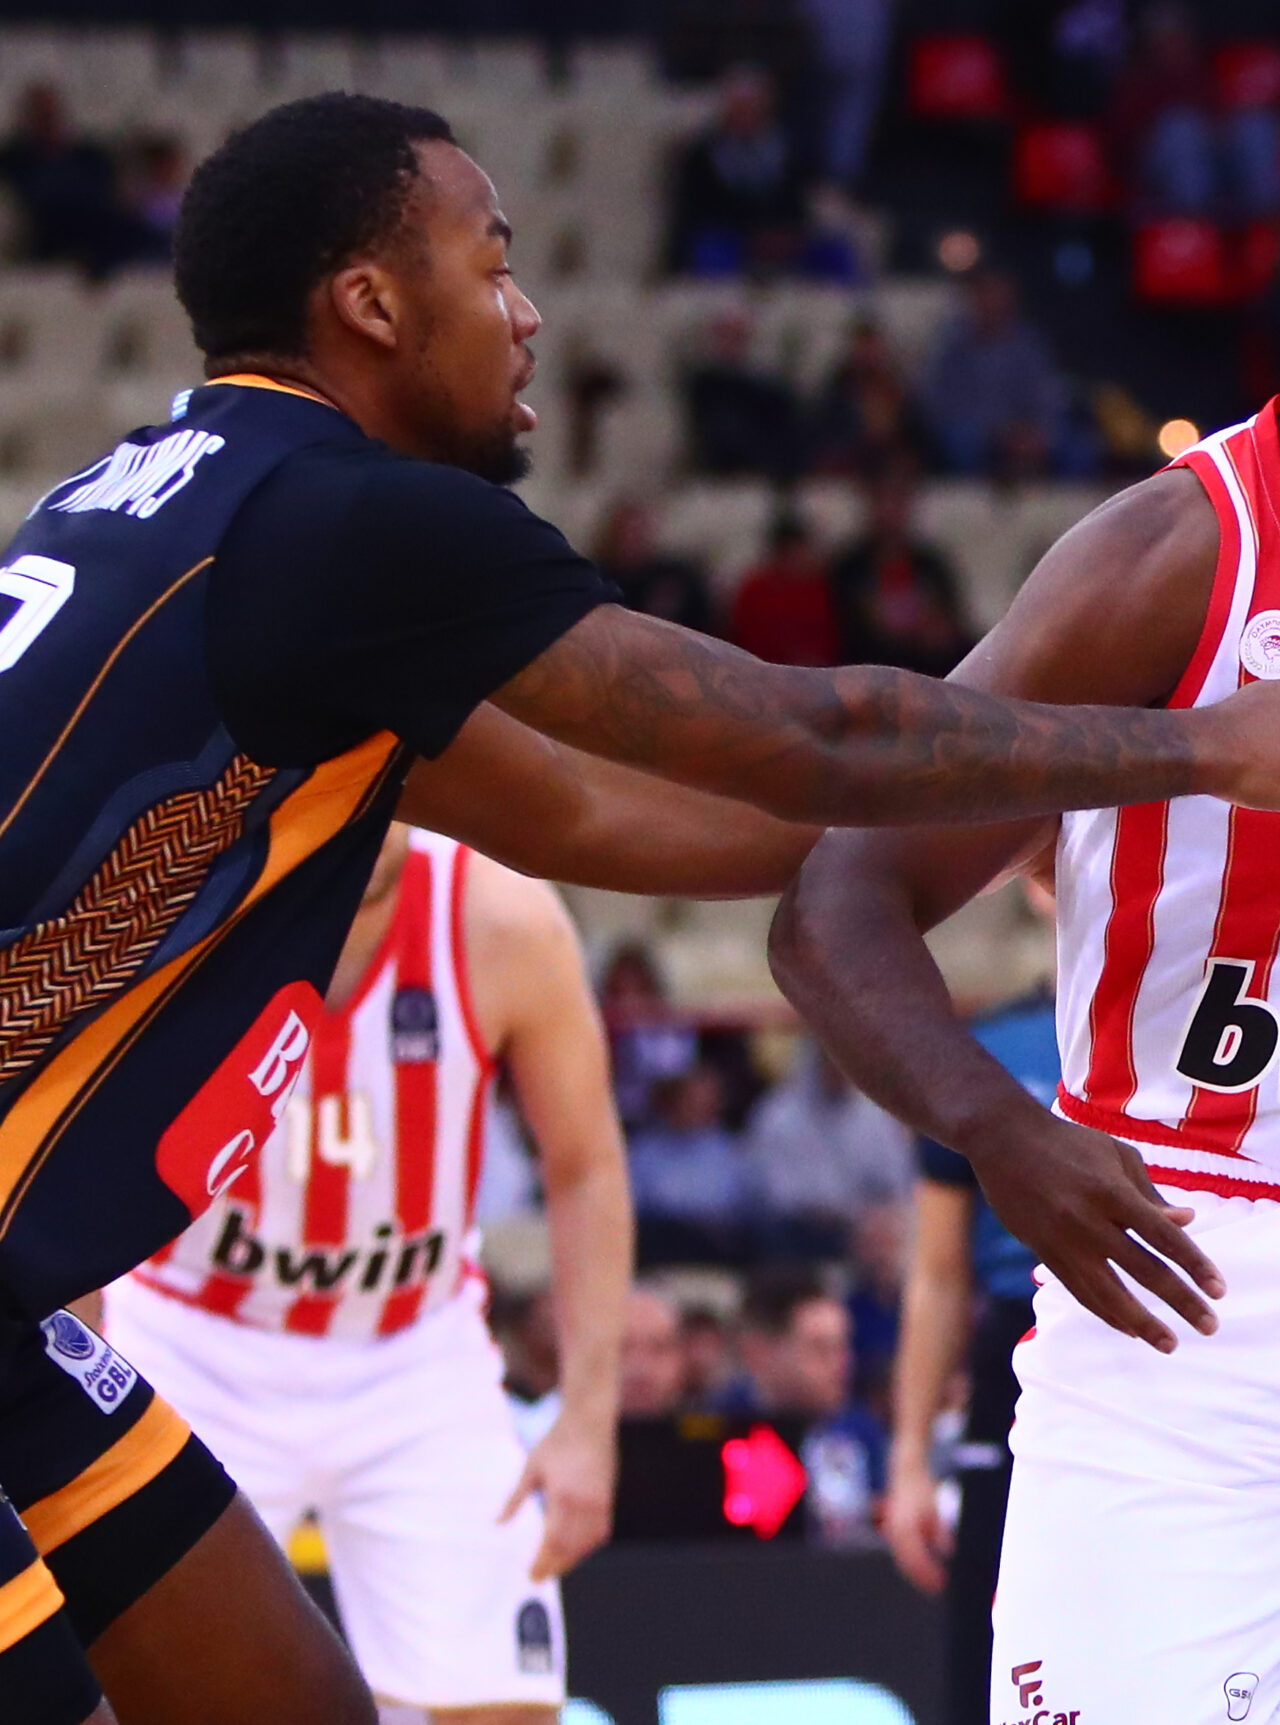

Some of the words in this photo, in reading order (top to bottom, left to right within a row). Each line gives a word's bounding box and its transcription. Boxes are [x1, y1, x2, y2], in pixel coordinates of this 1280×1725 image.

[286, 1095, 378, 1182] 14
[212, 1209, 444, 1291] bwin
[97, 1359, 132, 1403] GBL
